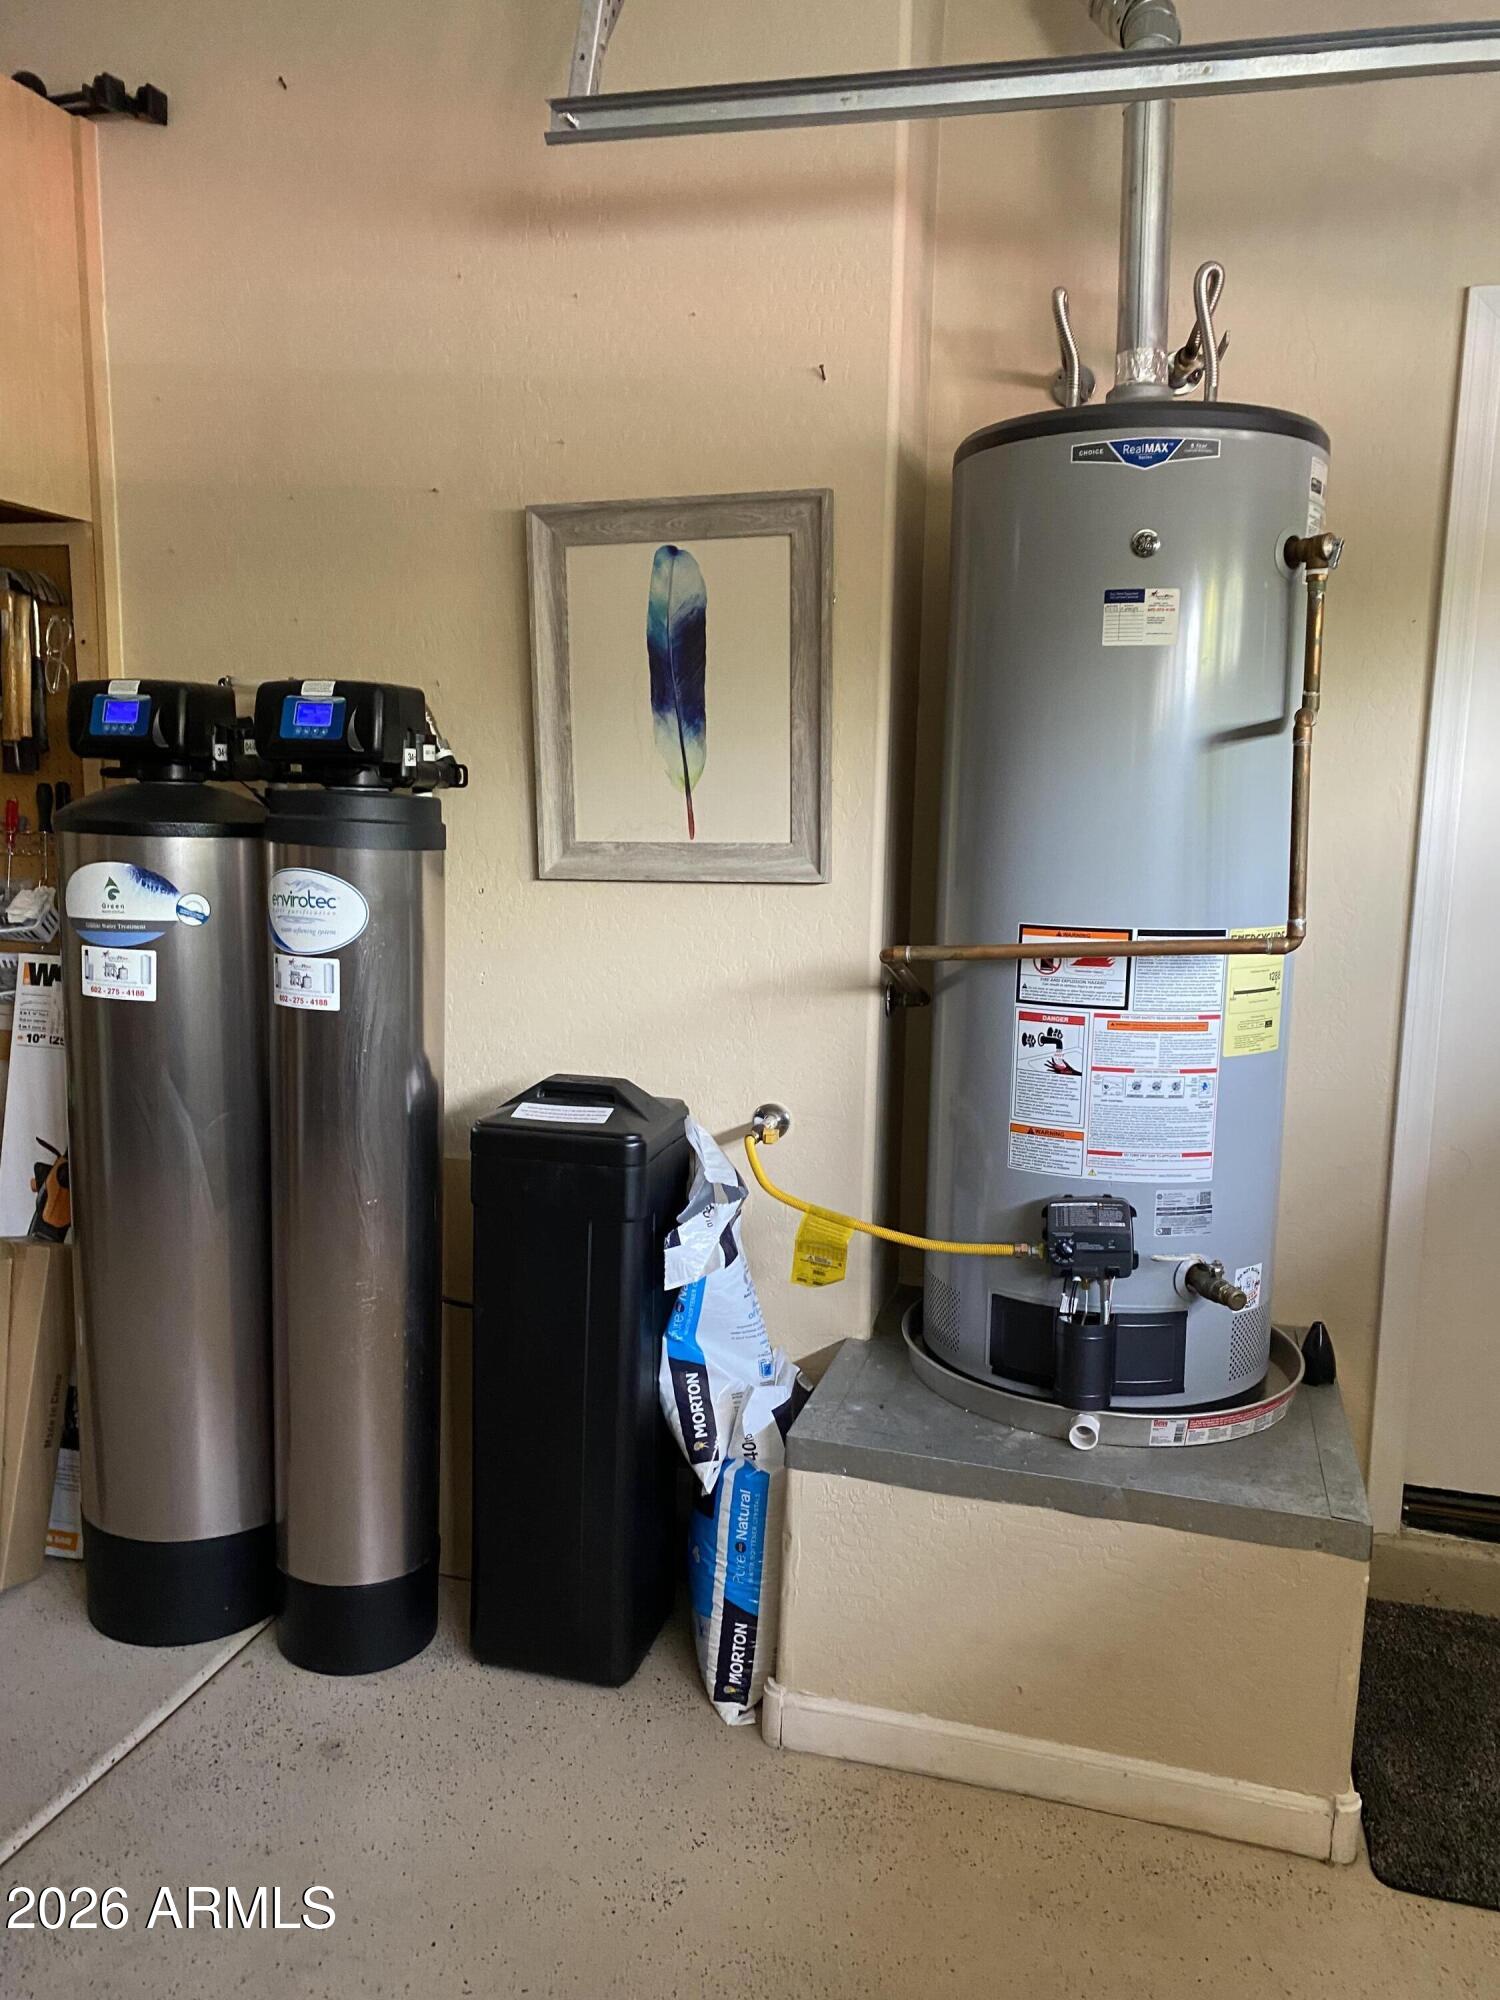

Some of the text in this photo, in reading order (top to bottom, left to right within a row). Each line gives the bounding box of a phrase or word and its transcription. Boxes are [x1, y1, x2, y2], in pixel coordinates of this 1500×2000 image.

[1078, 448, 1104, 457] CHOICE
[272, 889, 336, 909] envirotec
[1042, 1015, 1069, 1023] DANGER
[1035, 1128, 1065, 1137] WARNING
[686, 1372, 708, 1440] MORTON
[733, 1489, 751, 1585] Pure Natural
[729, 1621, 748, 1685] MORTON
